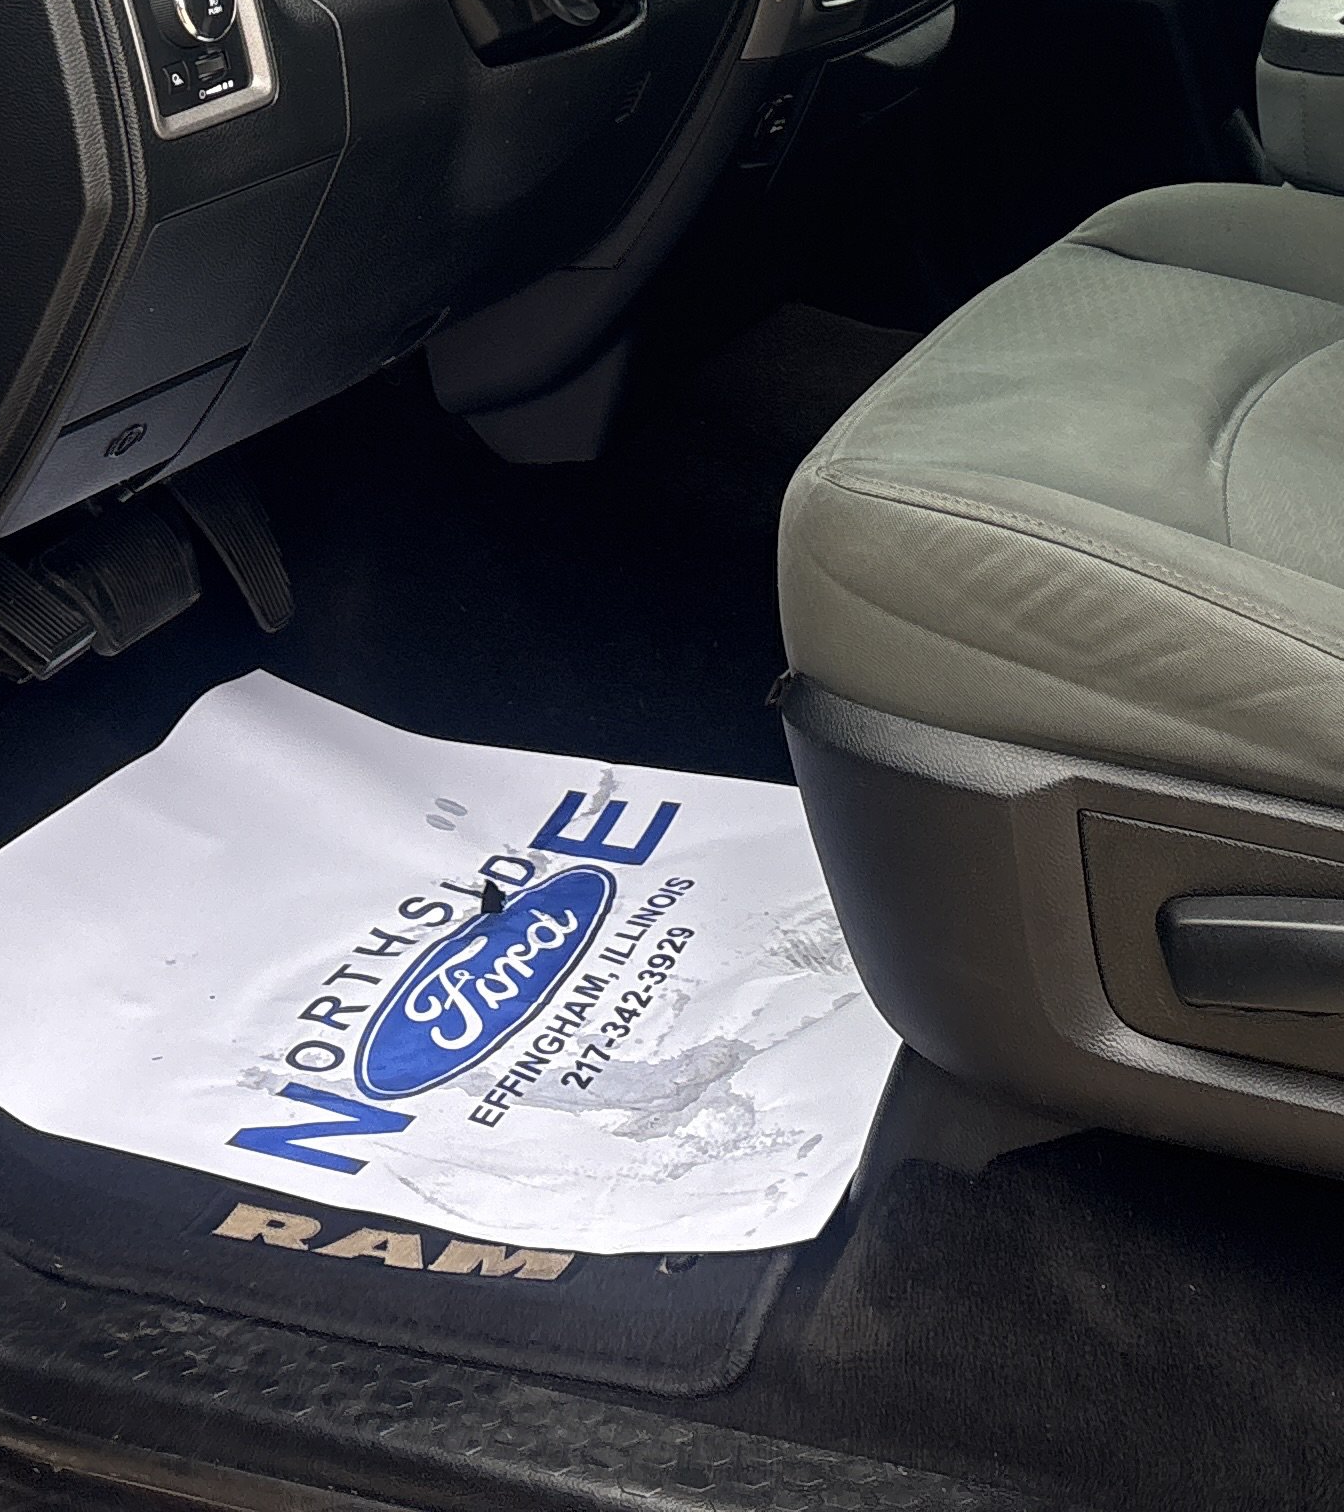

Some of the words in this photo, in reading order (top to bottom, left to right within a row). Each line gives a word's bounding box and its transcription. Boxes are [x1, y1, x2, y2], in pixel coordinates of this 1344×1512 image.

[225, 790, 682, 1175] NORTHSIDE
[404, 908, 579, 1050] Ford
[467, 972, 621, 1128] EFFINGHAM,
[598, 876, 696, 967] ILLINOIS
[560, 926, 696, 1091] 217-342-3929
[212, 1202, 575, 1281] RAM
